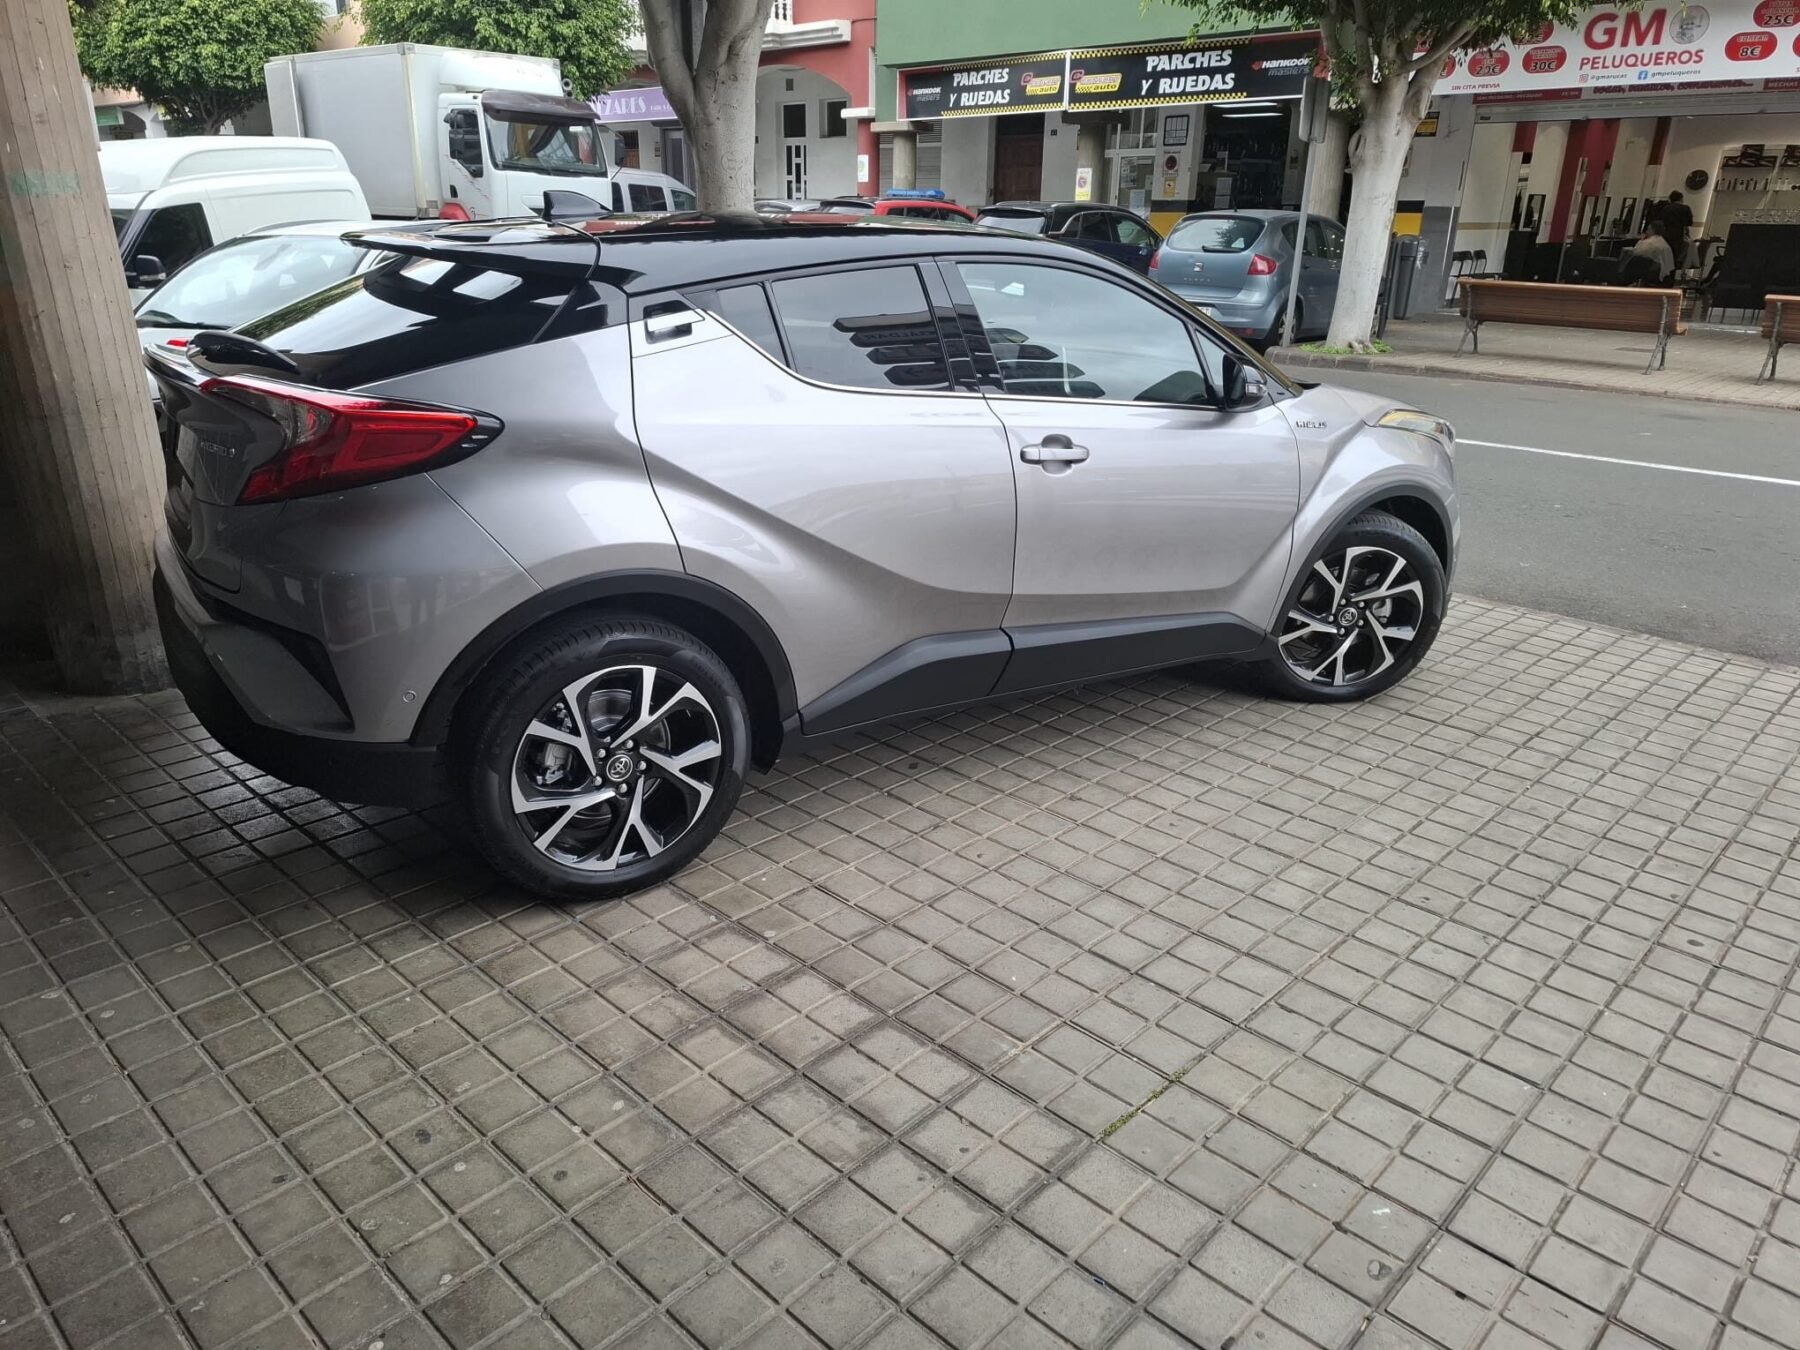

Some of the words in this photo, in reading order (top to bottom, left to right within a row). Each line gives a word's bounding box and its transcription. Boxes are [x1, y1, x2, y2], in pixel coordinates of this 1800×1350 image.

[1583, 8, 1667, 50] GM
[1763, 14, 1794, 26] 25€
[1579, 49, 1704, 71] PELUQUEROS
[1740, 46, 1761, 57] 8€
[1146, 50, 1232, 72] PARCHES
[1530, 60, 1556, 72] 30€
[953, 68, 1009, 87] PARCHES
[1094, 82, 1117, 91] auto
[1141, 81, 1150, 96] Y
[1158, 73, 1235, 95] RUEDAS
[950, 93, 957, 107] Y
[960, 89, 1010, 106] RUEDAS
